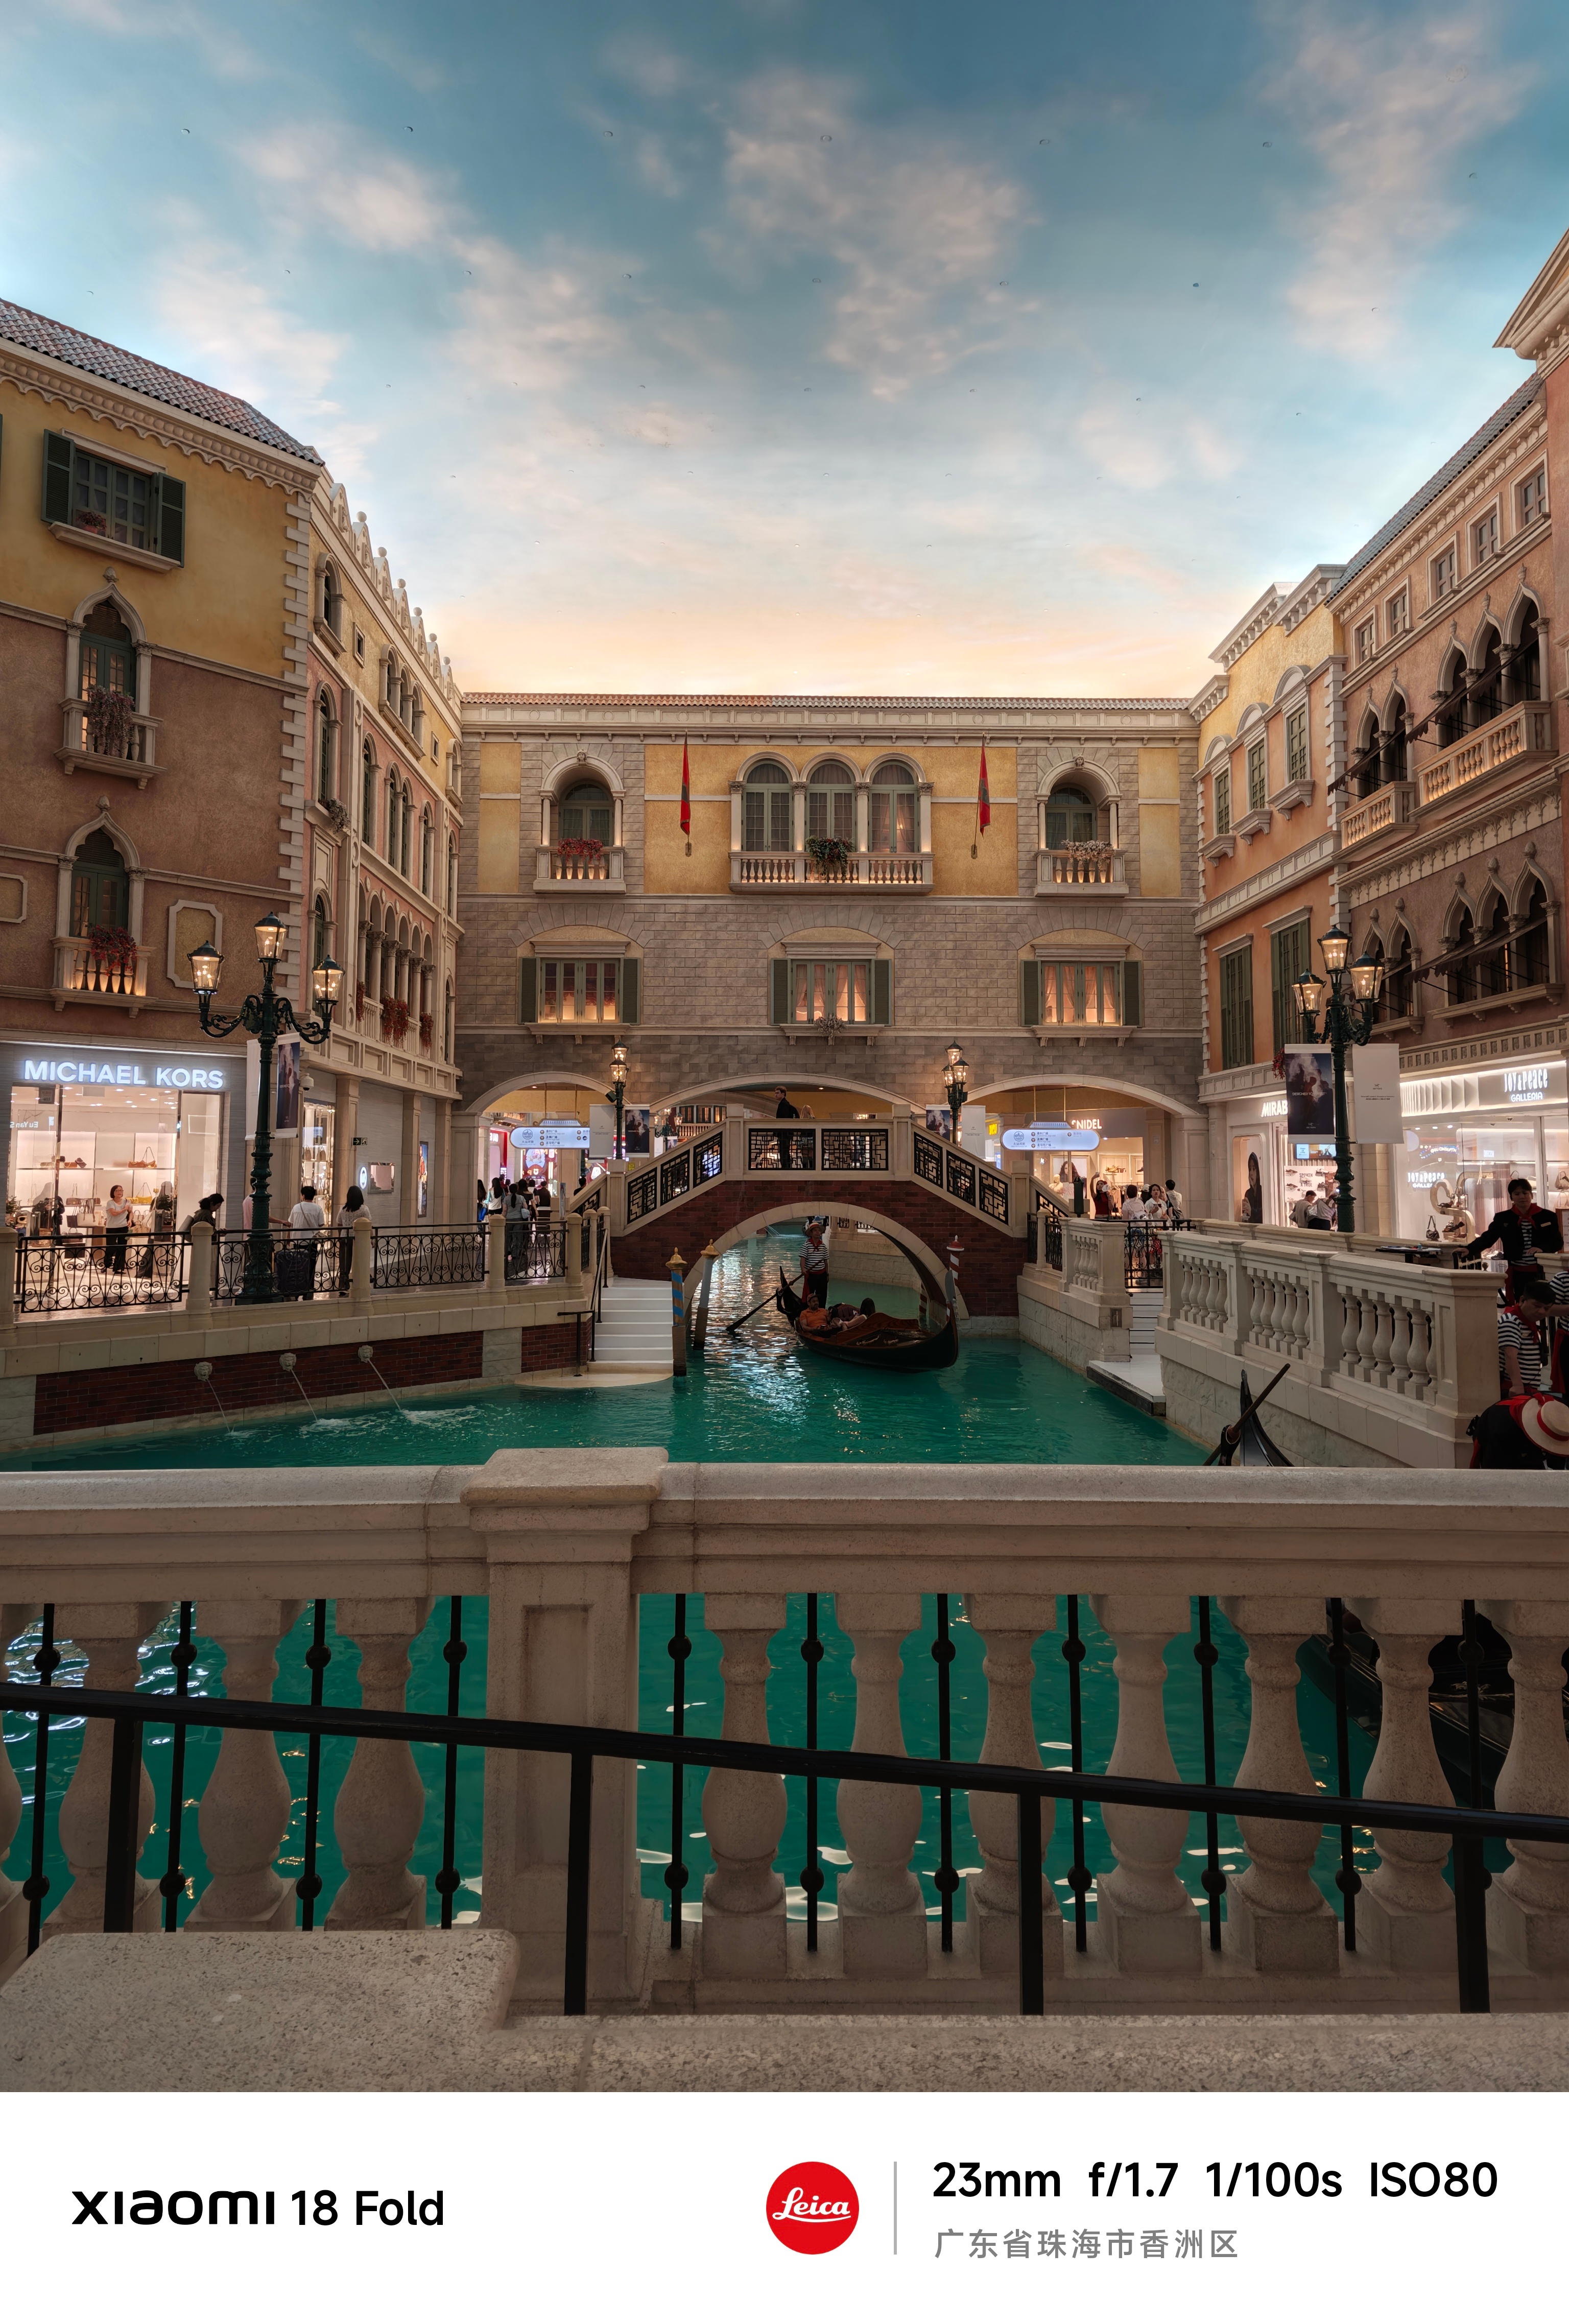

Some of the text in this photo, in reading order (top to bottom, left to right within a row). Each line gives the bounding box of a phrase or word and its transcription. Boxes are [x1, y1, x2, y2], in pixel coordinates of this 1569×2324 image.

[25, 1060, 223, 1089] MICHAEL KORS
[1510, 1092, 1543, 1102] GALLERIA
